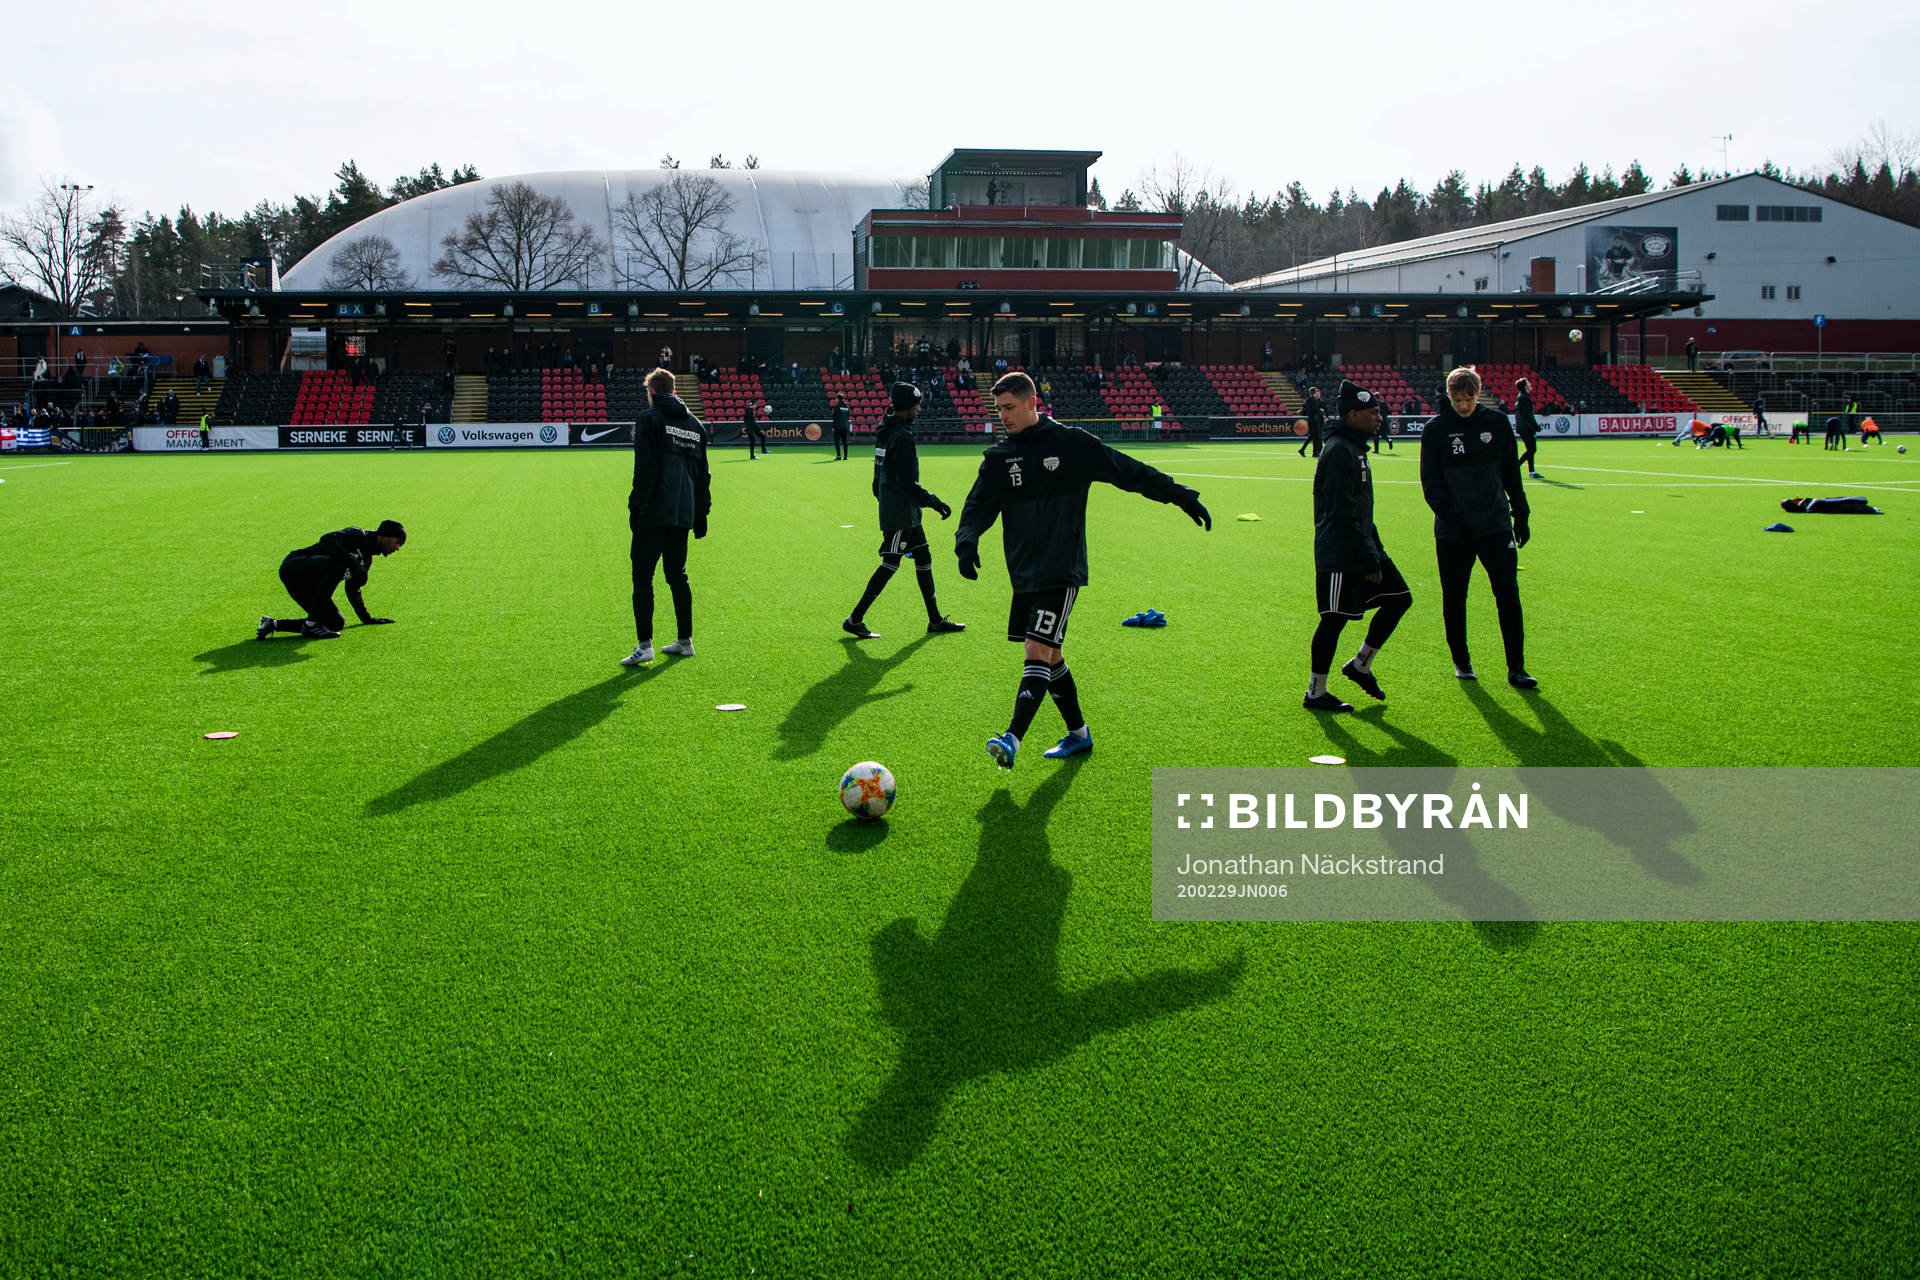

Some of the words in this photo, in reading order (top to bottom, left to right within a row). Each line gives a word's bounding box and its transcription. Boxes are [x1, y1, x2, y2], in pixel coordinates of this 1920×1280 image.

[340, 304, 348, 314] B
[353, 304, 361, 314] X
[590, 303, 598, 313] B
[834, 303, 842, 312] C
[1147, 303, 1155, 313] D
[71, 326, 80, 335] A
[1599, 416, 1676, 432] BAUHAUS
[1722, 415, 1753, 423] OFFICE
[741, 426, 803, 438] Sdbank
[1235, 422, 1291, 433] Swedbank
[166, 429, 201, 439] OFFIC
[289, 431, 347, 443] SERNEKE
[357, 430, 414, 442] SERNE
[461, 430, 534, 442] Volkswagen
[1452, 444, 1465, 455] 24
[1010, 473, 1023, 487] 13
[1034, 609, 1057, 635] 13
